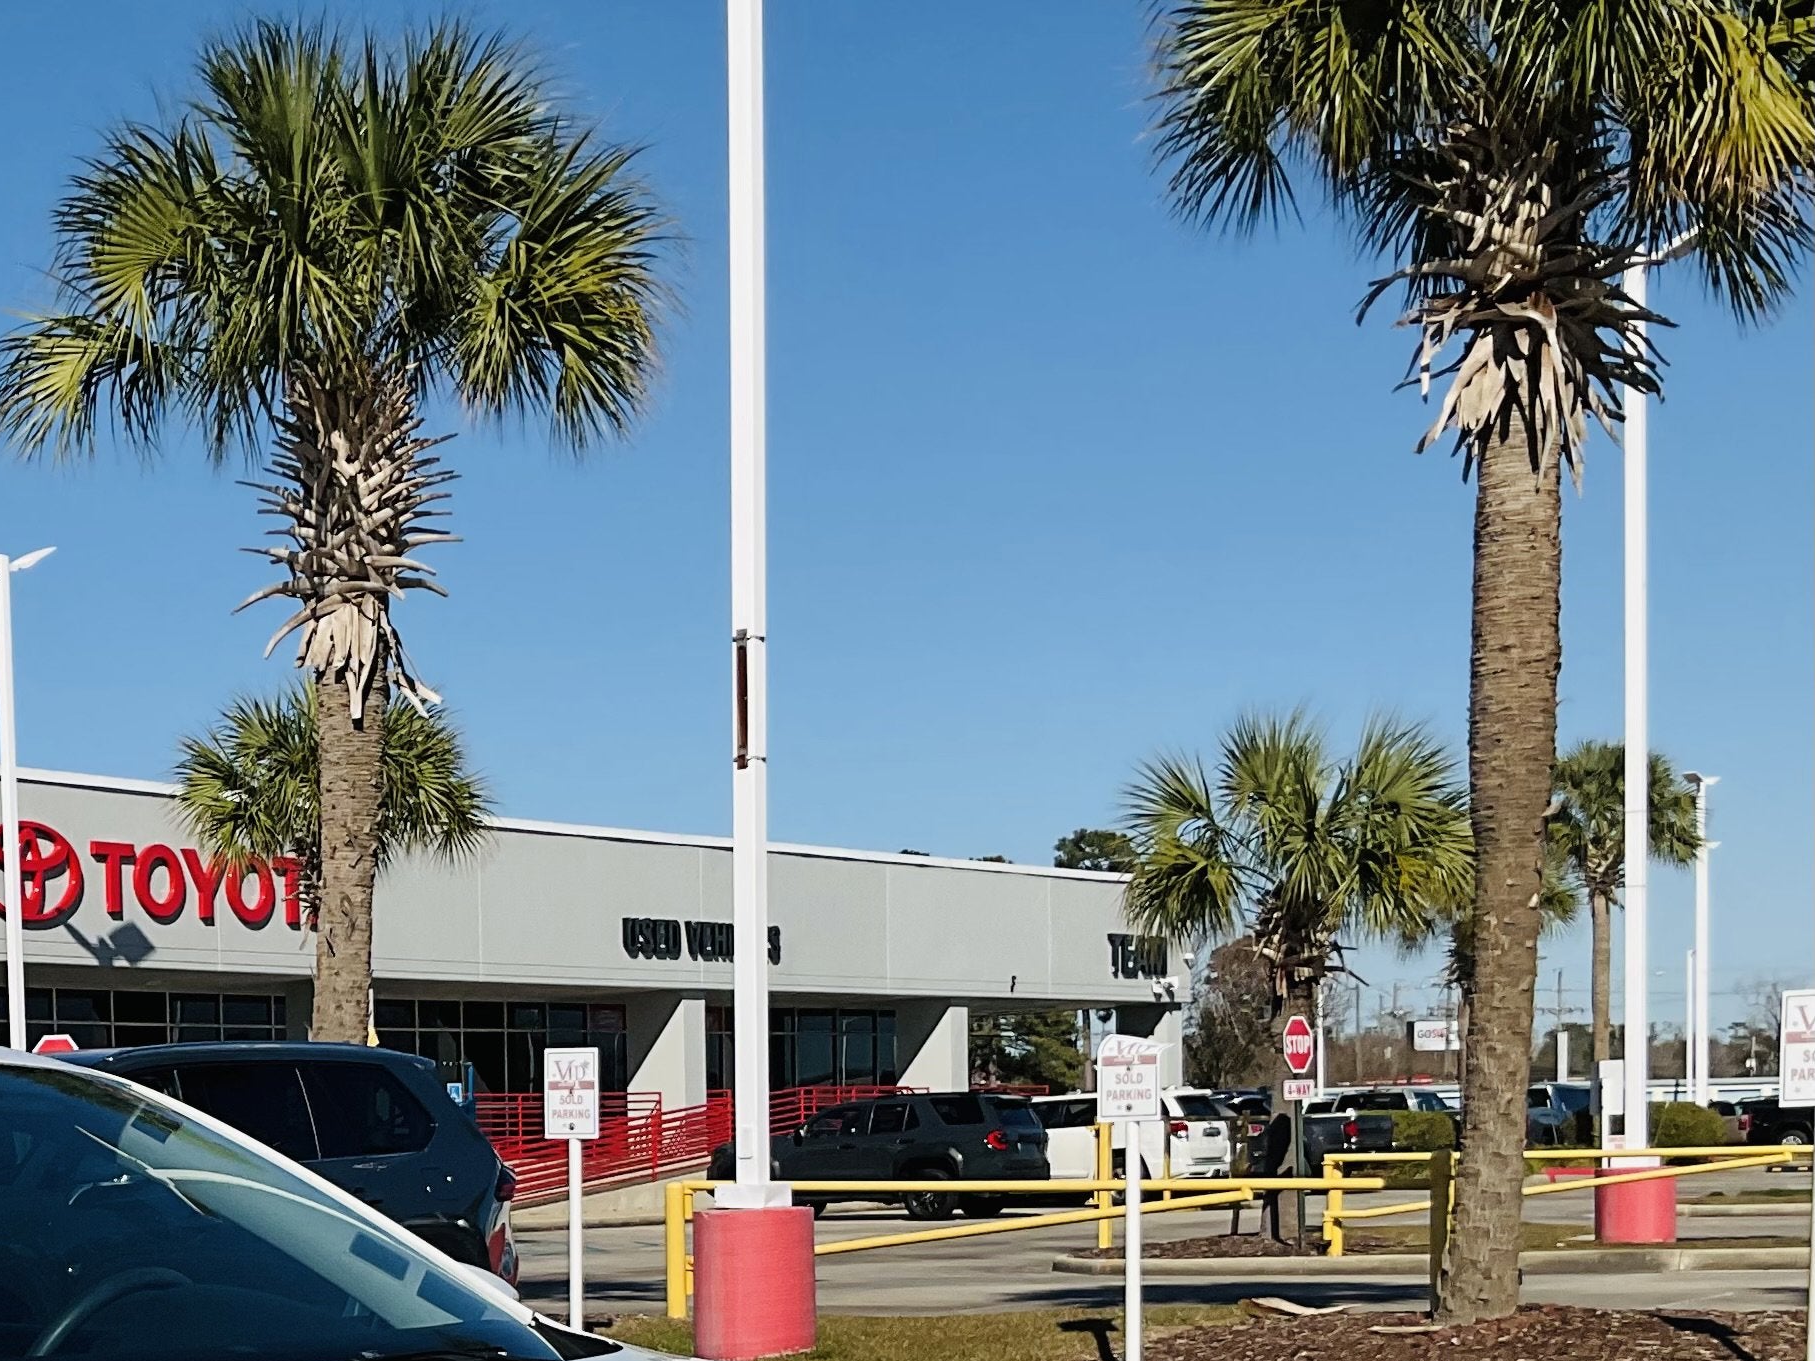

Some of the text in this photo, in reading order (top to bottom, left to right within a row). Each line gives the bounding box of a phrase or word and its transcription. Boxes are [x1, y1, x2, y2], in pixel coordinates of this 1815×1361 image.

[90, 840, 318, 931] TOYOT
[622, 918, 781, 966] USED VEHIS
[1286, 1034, 1310, 1055] STOP
[1114, 1072, 1144, 1085] SOLD
[1106, 1088, 1153, 1102] PARKING
[1287, 1083, 1311, 1096] 4-WAY
[558, 1094, 584, 1105] SOLD
[551, 1108, 591, 1120] PARKING
